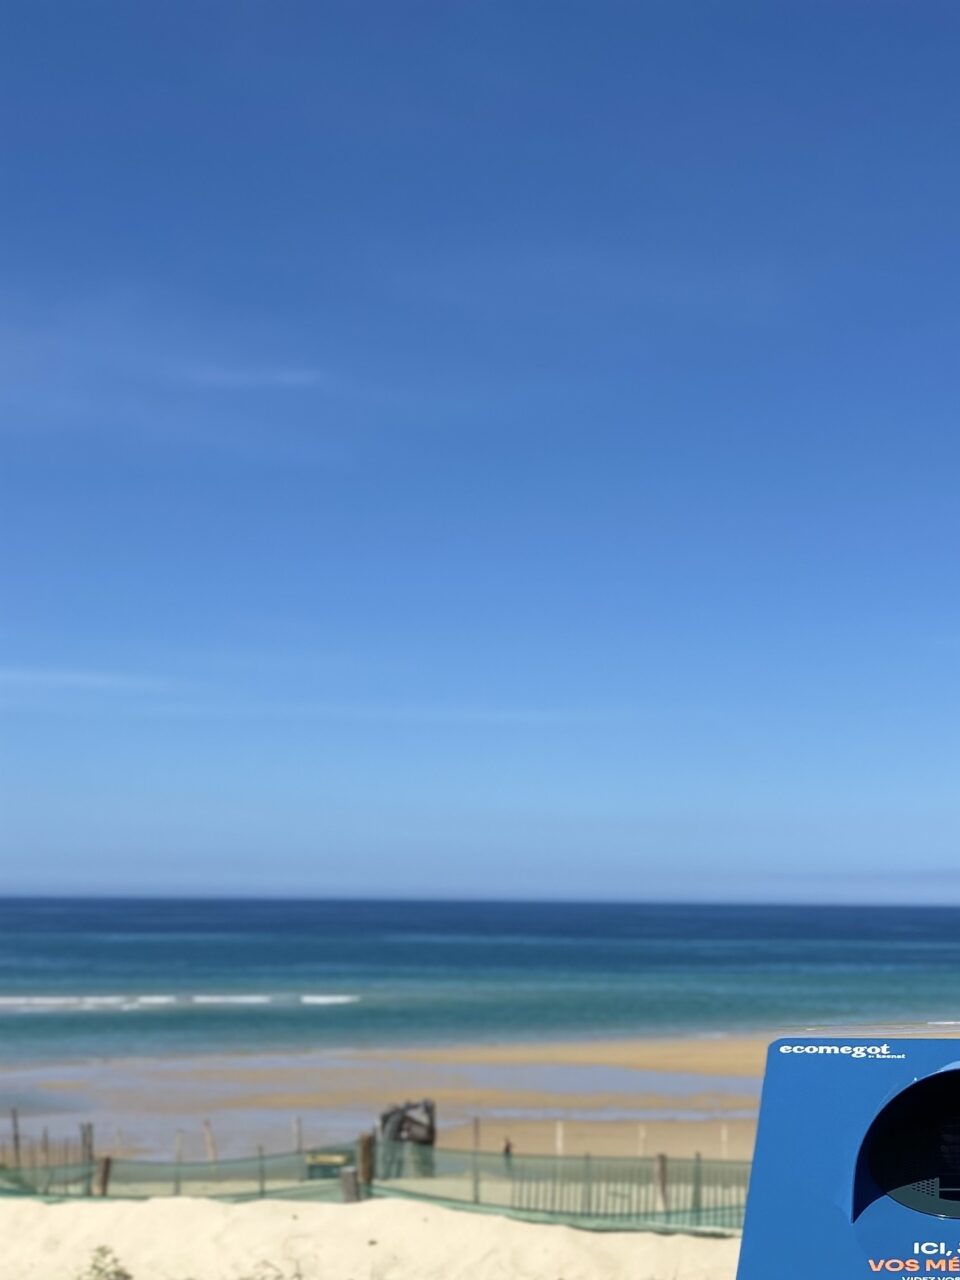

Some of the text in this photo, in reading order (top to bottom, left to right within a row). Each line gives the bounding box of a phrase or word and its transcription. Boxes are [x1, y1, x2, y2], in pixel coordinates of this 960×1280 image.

[779, 1043, 890, 1058] ecomegot
[913, 1242, 953, 1257] ICI,
[868, 1259, 920, 1272] VOS
